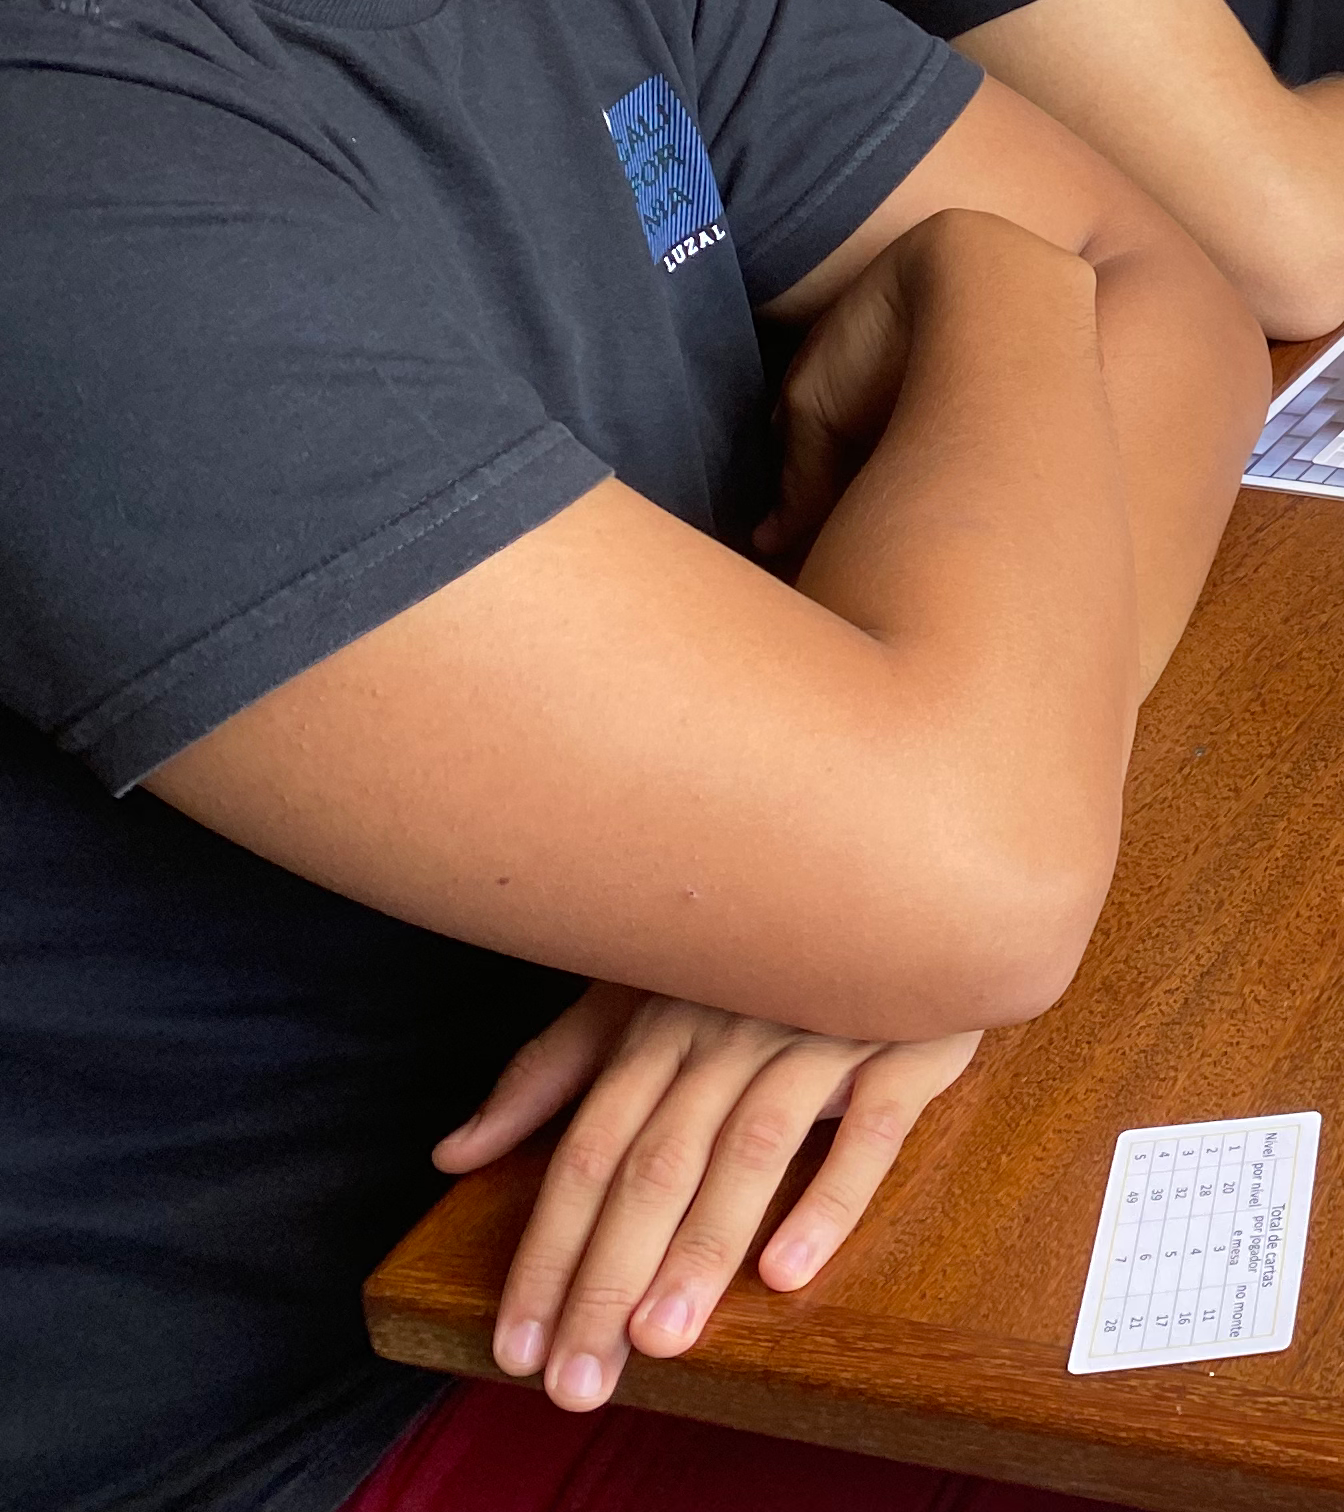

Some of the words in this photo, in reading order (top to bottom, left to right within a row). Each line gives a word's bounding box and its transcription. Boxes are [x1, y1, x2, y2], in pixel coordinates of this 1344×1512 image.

[663, 224, 726, 273] LUZAL
[1263, 1132, 1277, 1157] Nível
[1251, 1163, 1264, 1181] por
[1175, 1187, 1188, 1200] 32
[1200, 1184, 1212, 1197] 28
[1222, 1181, 1235, 1194] 20
[1249, 1182, 1261, 1207] nível
[1126, 1191, 1138, 1204] 49
[1151, 1189, 1164, 1201] 39
[1269, 1203, 1286, 1231] Total
[1254, 1216, 1264, 1233] por
[1267, 1234, 1282, 1249] de
[1230, 1238, 1242, 1266] mesa
[1247, 1235, 1262, 1274] jogador
[1261, 1254, 1277, 1288] cartas
[1235, 1285, 1247, 1299] no
[1156, 1314, 1169, 1327] 17
[1178, 1312, 1191, 1325] 16
[1202, 1309, 1216, 1321] 11
[1229, 1301, 1244, 1338] monte
[1104, 1319, 1118, 1333] 28
[1129, 1316, 1143, 1330] 21
